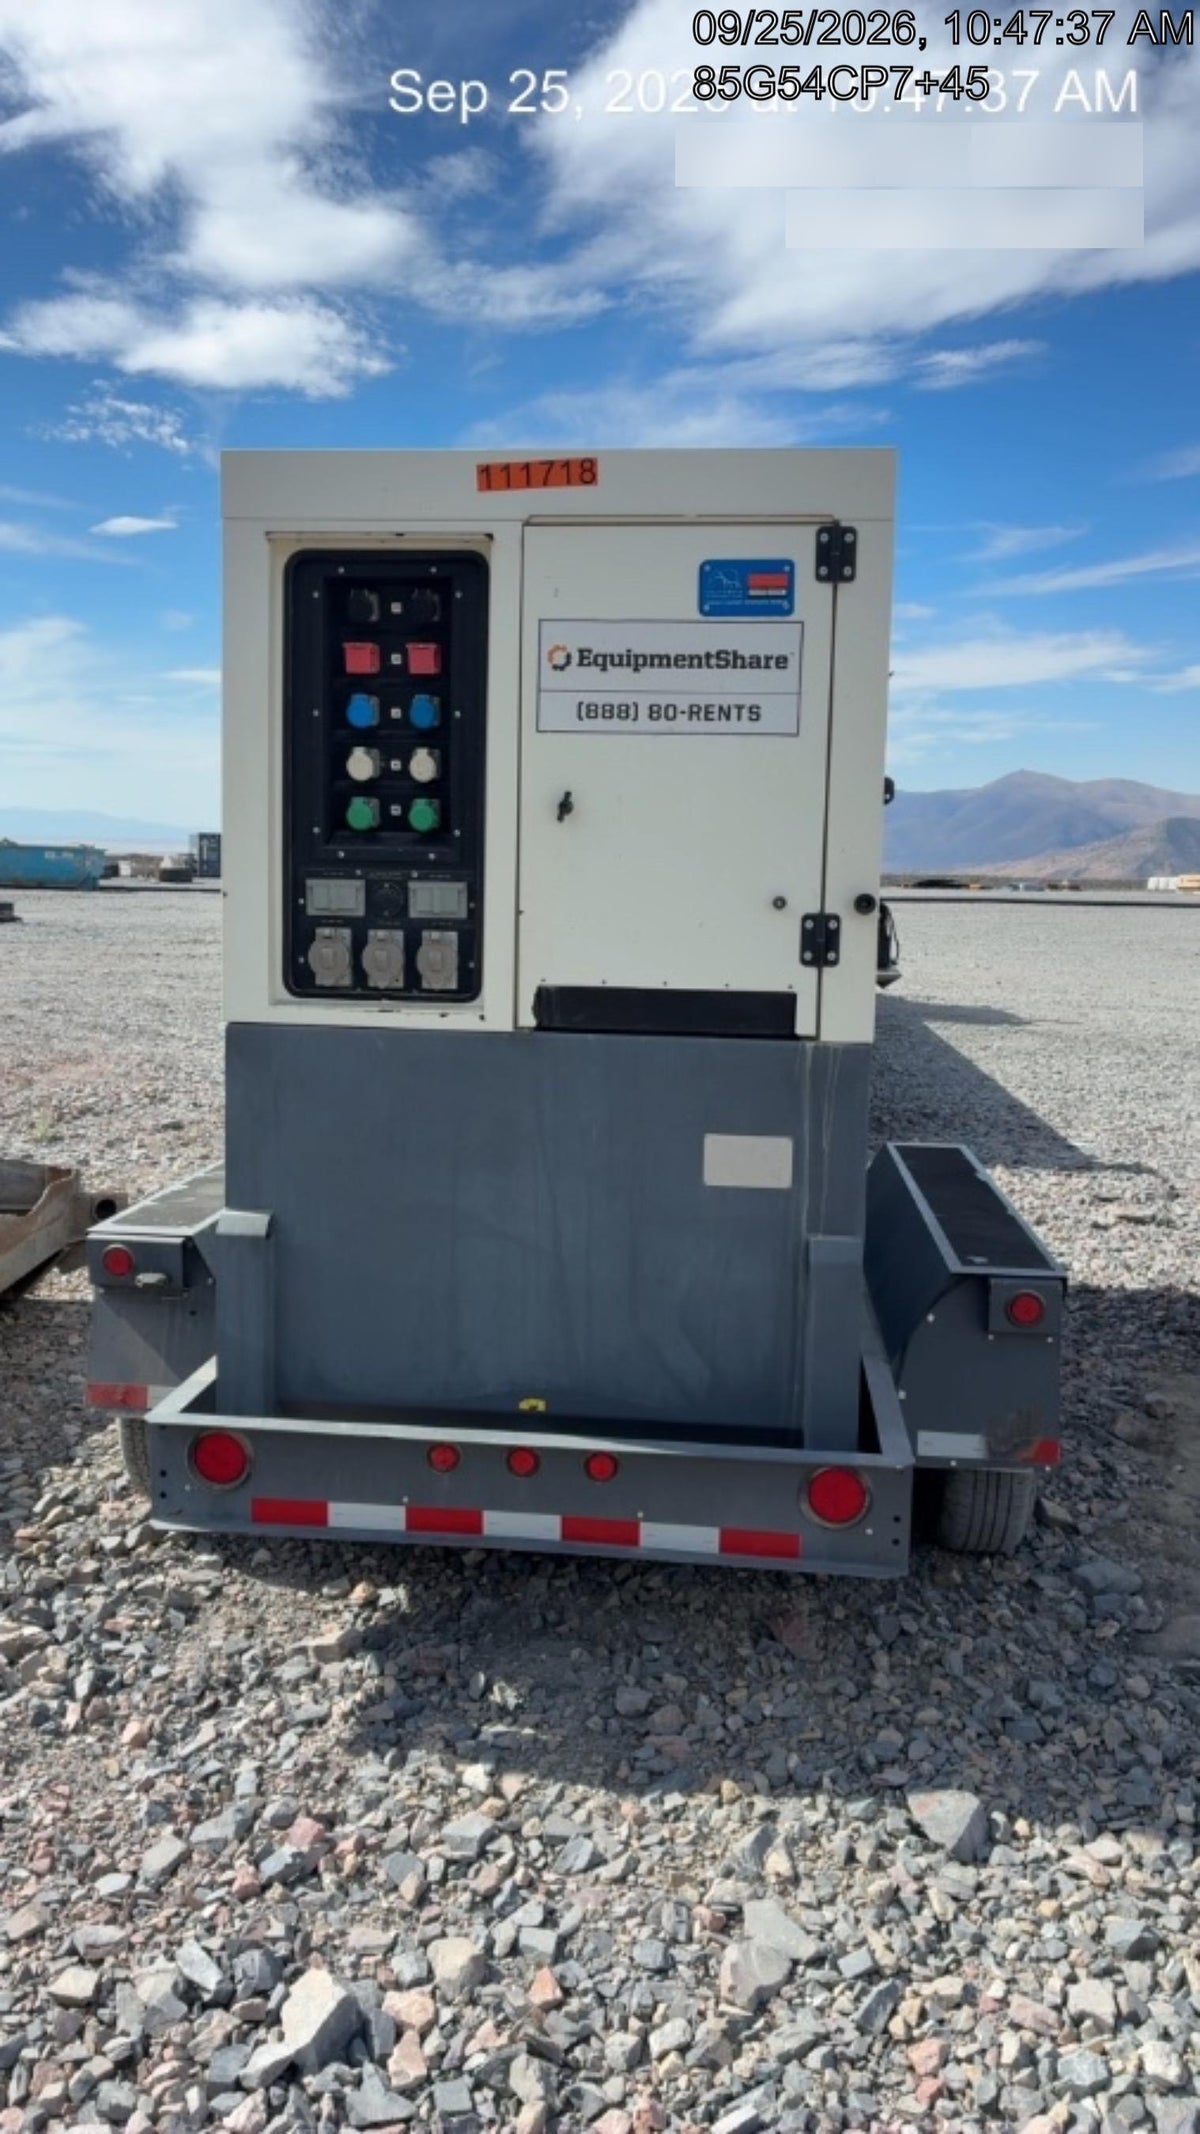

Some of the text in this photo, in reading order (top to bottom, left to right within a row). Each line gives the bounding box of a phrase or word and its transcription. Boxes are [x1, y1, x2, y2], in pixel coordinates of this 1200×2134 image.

[480, 458, 597, 489] 111718
[576, 648, 789, 673] EquipmentShare
[576, 701, 763, 723] (888) 80-RENTS
